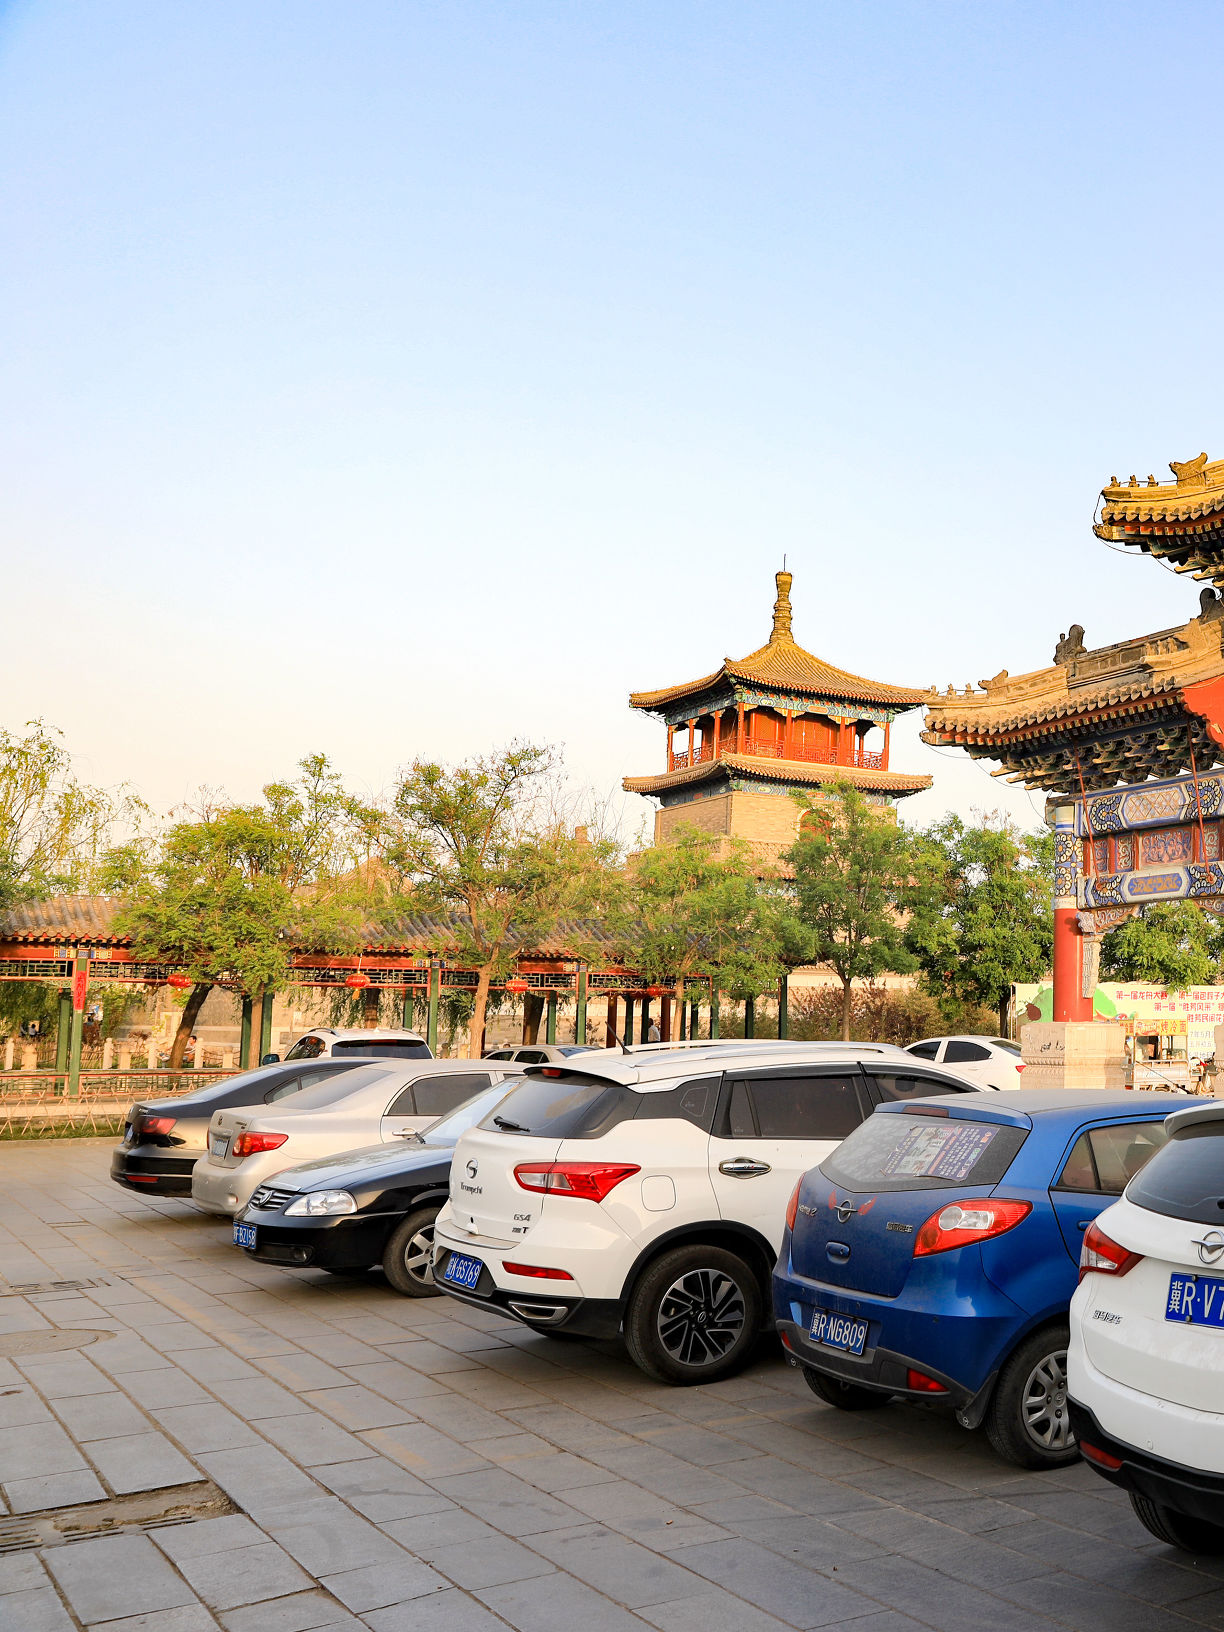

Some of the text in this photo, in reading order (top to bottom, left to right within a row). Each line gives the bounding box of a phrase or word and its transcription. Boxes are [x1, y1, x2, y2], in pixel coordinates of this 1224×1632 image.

[1116, 990, 1168, 1000] 第一届龙舟大赛
[460, 1182, 482, 1195] Trumpchi
[513, 1213, 532, 1222] GS4
